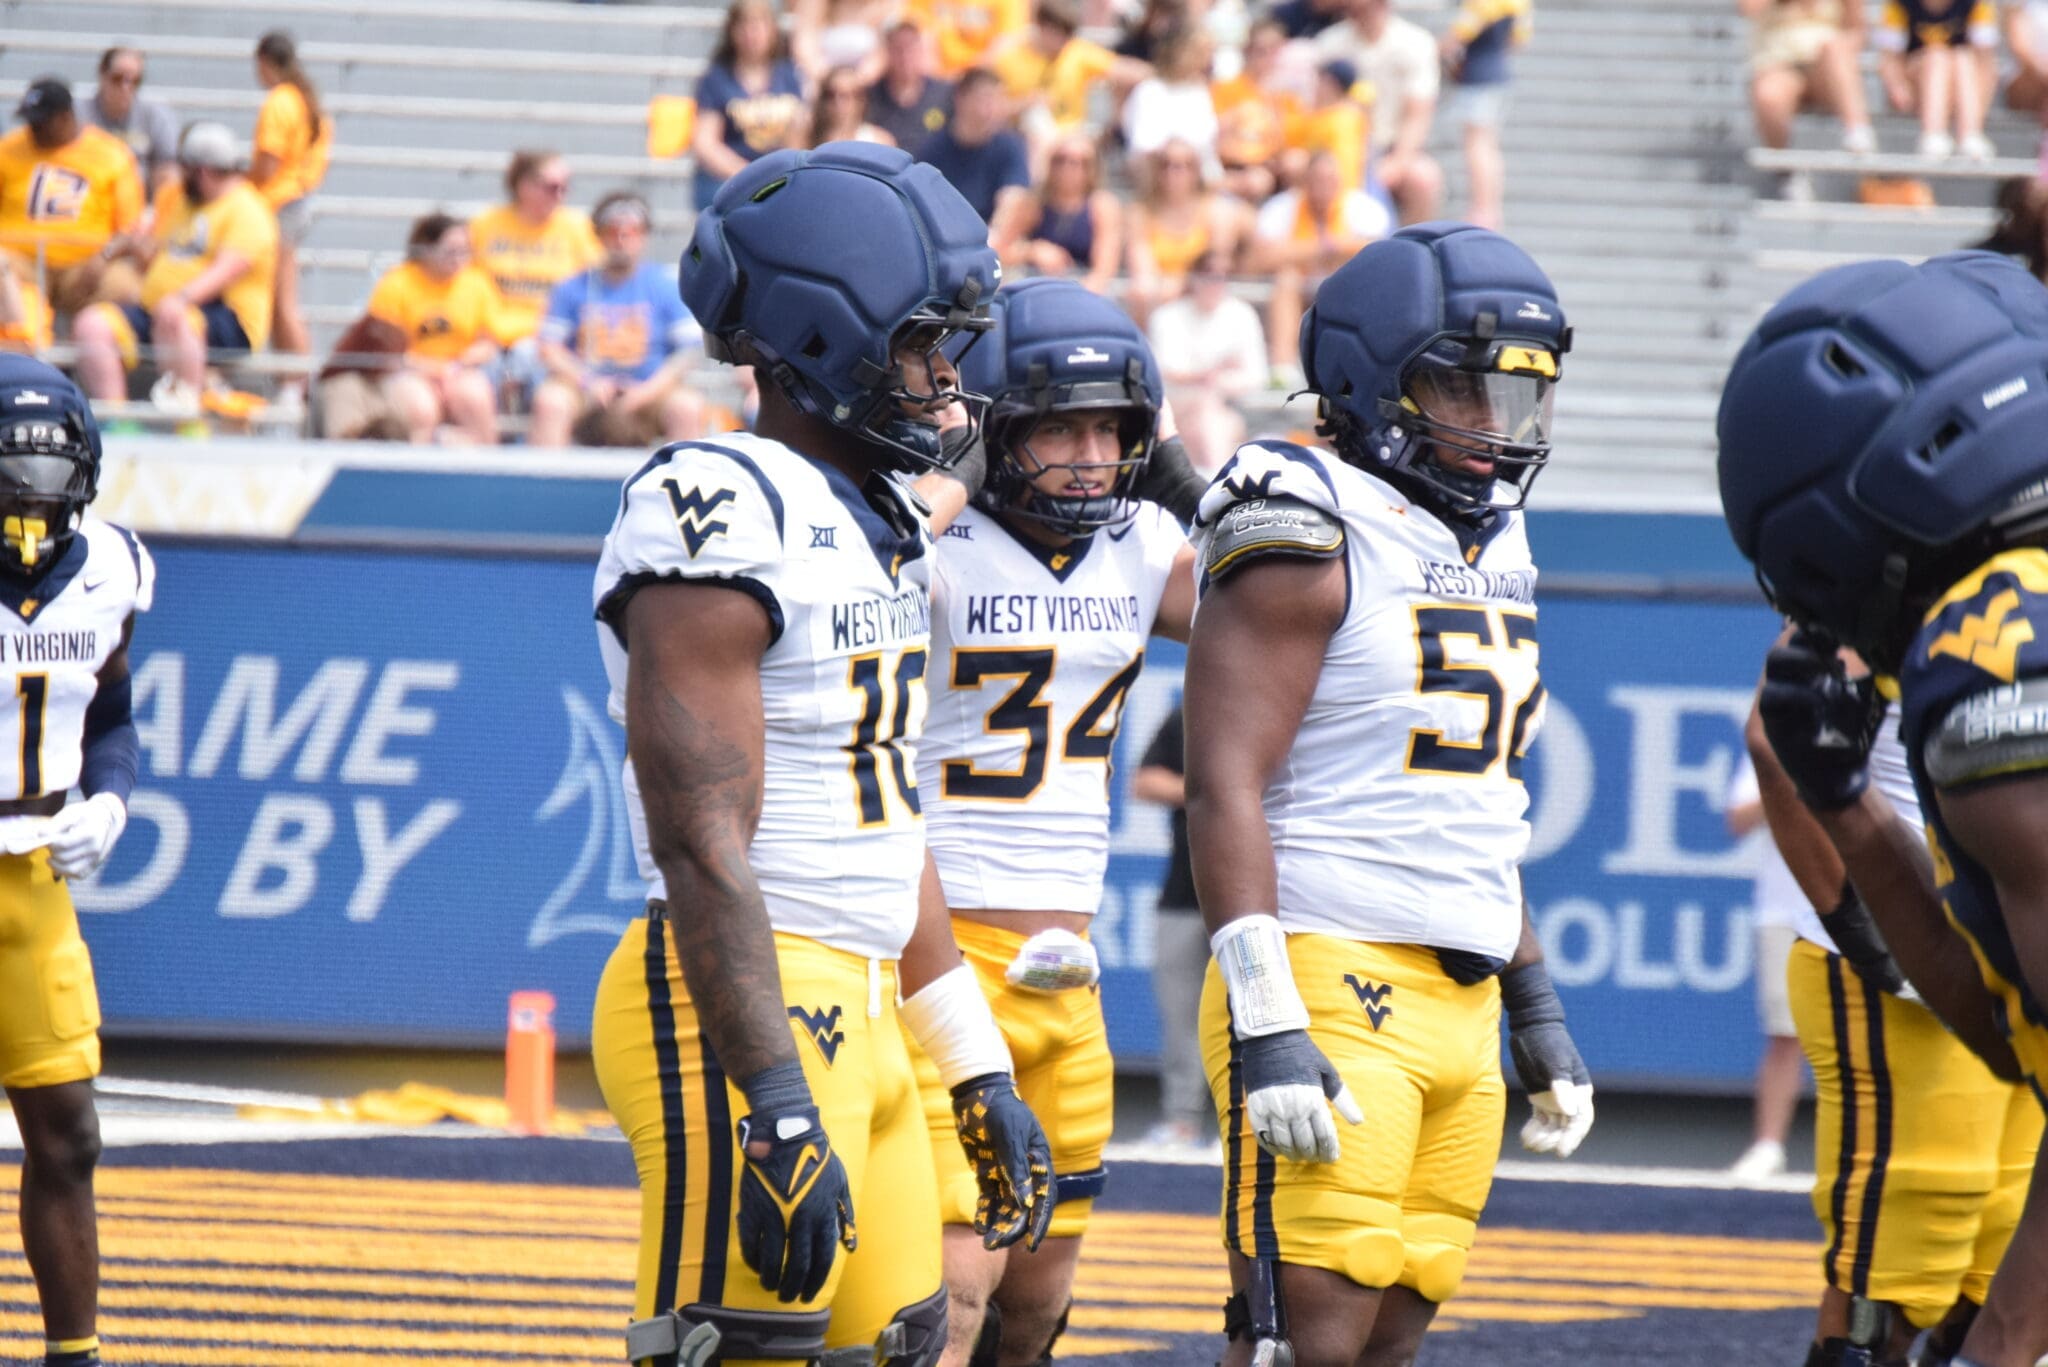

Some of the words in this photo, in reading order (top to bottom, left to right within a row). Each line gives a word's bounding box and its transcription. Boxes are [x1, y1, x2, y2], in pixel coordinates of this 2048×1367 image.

[1416, 559, 1476, 596] WEST
[832, 598, 884, 650] WEST
[967, 595, 1037, 634] WEST
[1044, 595, 1141, 633] VIRGINIA
[13, 629, 96, 663] VIRGINIA
[16, 671, 49, 801] 1
[940, 645, 1146, 804] 34
[216, 791, 466, 922] BY
